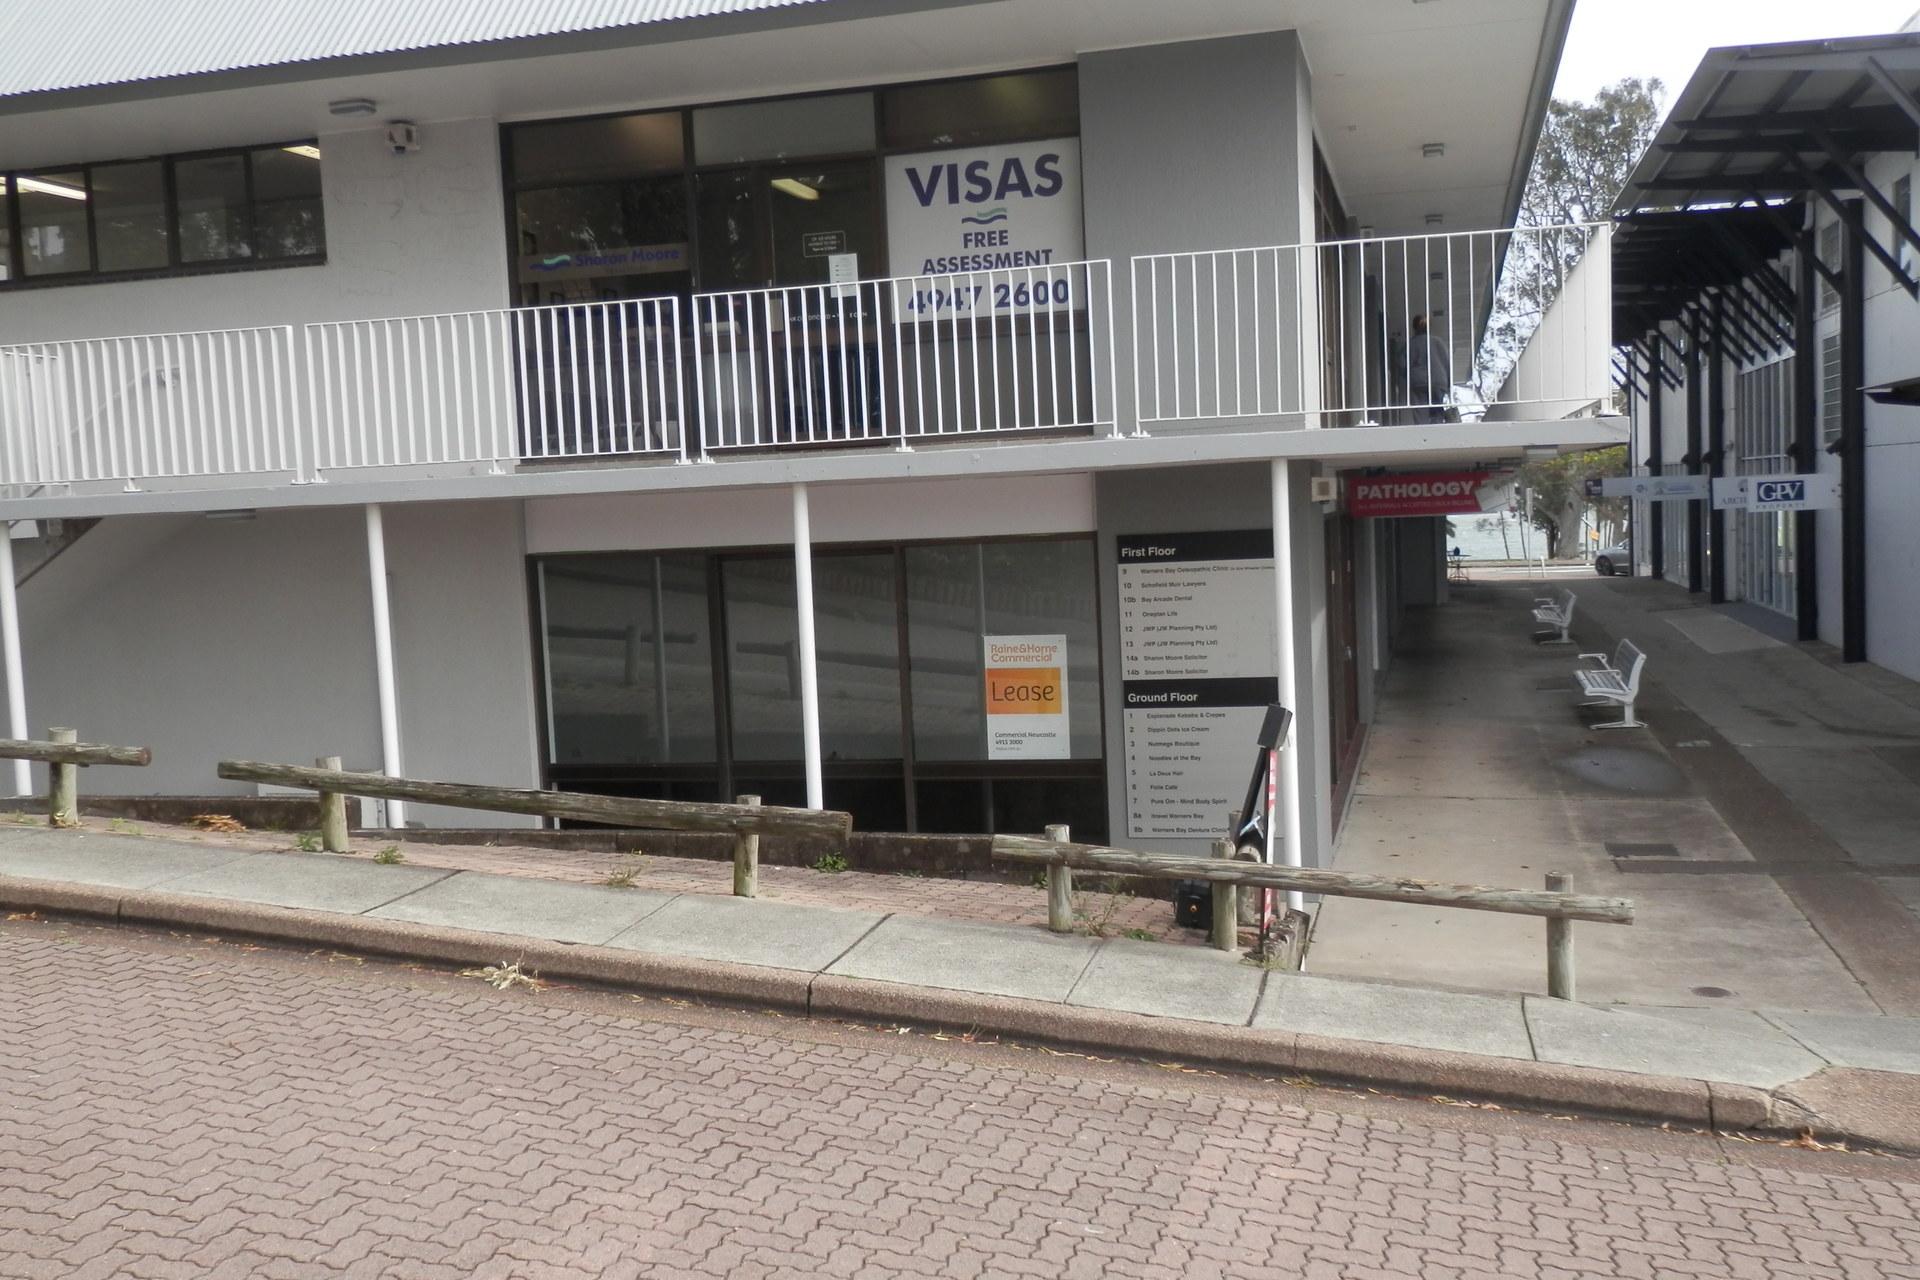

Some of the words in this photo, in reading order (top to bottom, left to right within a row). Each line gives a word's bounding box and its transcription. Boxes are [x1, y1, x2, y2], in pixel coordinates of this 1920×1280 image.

[905, 153, 1063, 207] VISAS
[963, 230, 1009, 249] FREE
[575, 254, 627, 267] Sharon
[632, 249, 681, 263] Moore
[922, 249, 1053, 275] ASSESSMENT
[908, 285, 984, 314] 4947
[994, 279, 1069, 308] 2600
[1357, 481, 1474, 500] PATHOLOGY
[1758, 482, 1802, 501] GPV
[1121, 547, 1145, 558] First
[1148, 546, 1176, 557] Floor
[991, 653, 1053, 663] Commercial
[992, 680, 1054, 702] Lease
[1128, 693, 1168, 703] Ground
[1170, 692, 1199, 703] Floor
[1195, 798, 1211, 806] Body
[1212, 798, 1228, 806] Spirit
